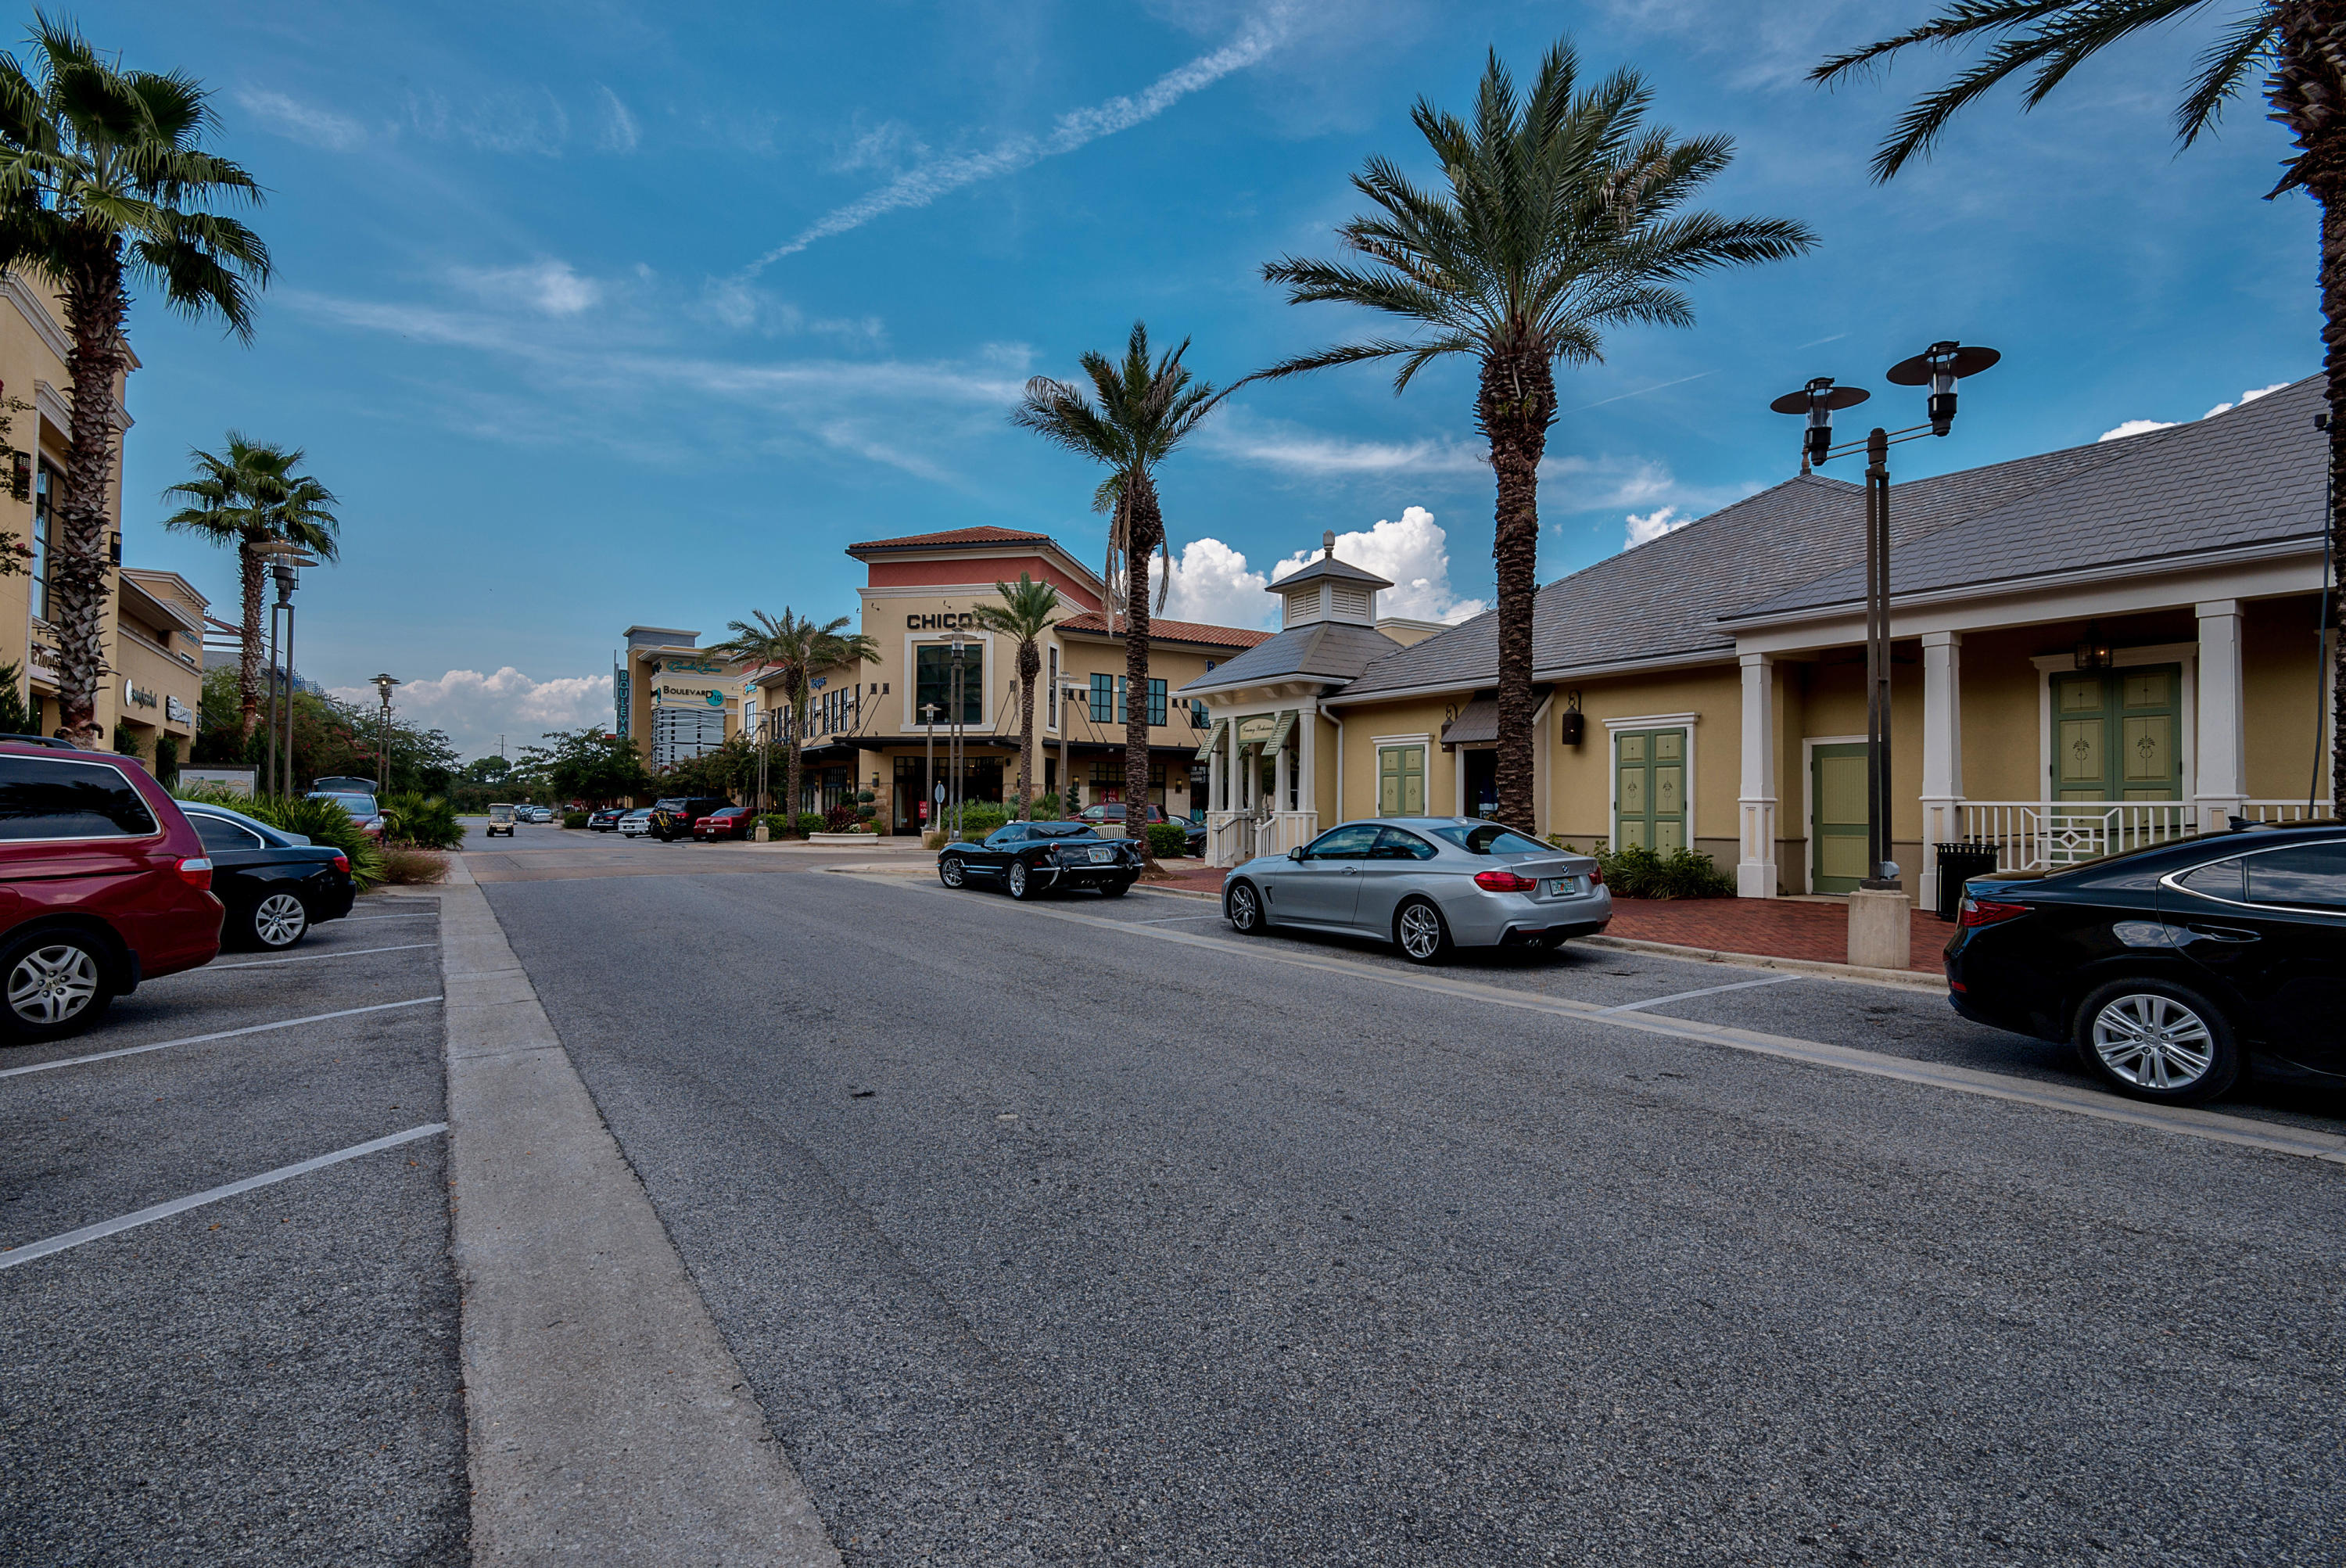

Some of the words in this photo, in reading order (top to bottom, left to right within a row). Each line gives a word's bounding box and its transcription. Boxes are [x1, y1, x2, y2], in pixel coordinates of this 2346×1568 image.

[907, 612, 974, 629] CHICO
[663, 685, 713, 698] BOULEVARD
[619, 673, 629, 741] BOULEVA
